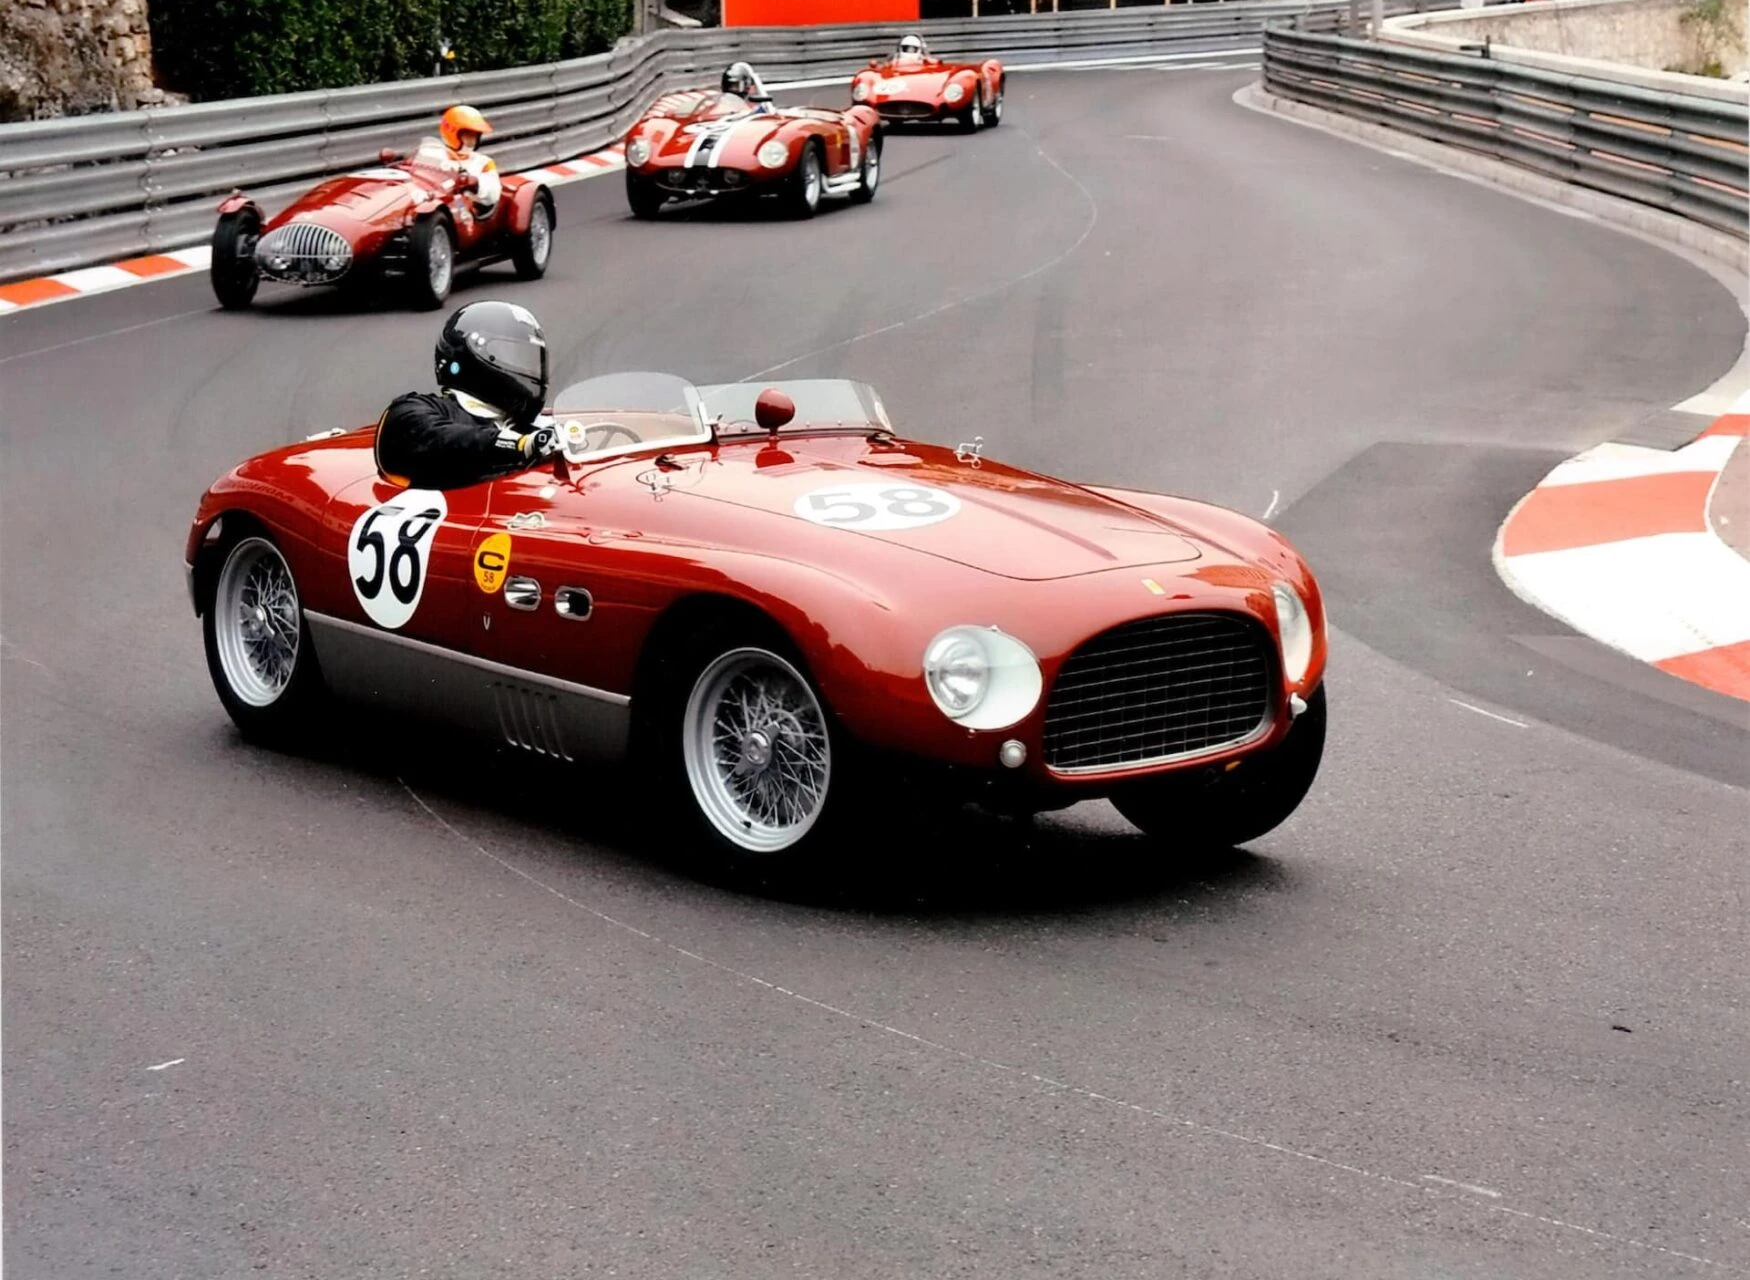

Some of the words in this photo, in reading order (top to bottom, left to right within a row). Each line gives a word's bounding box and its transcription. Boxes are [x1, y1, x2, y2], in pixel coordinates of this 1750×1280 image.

[808, 488, 950, 523] 58
[355, 506, 441, 605] 58
[478, 551, 505, 572] C
